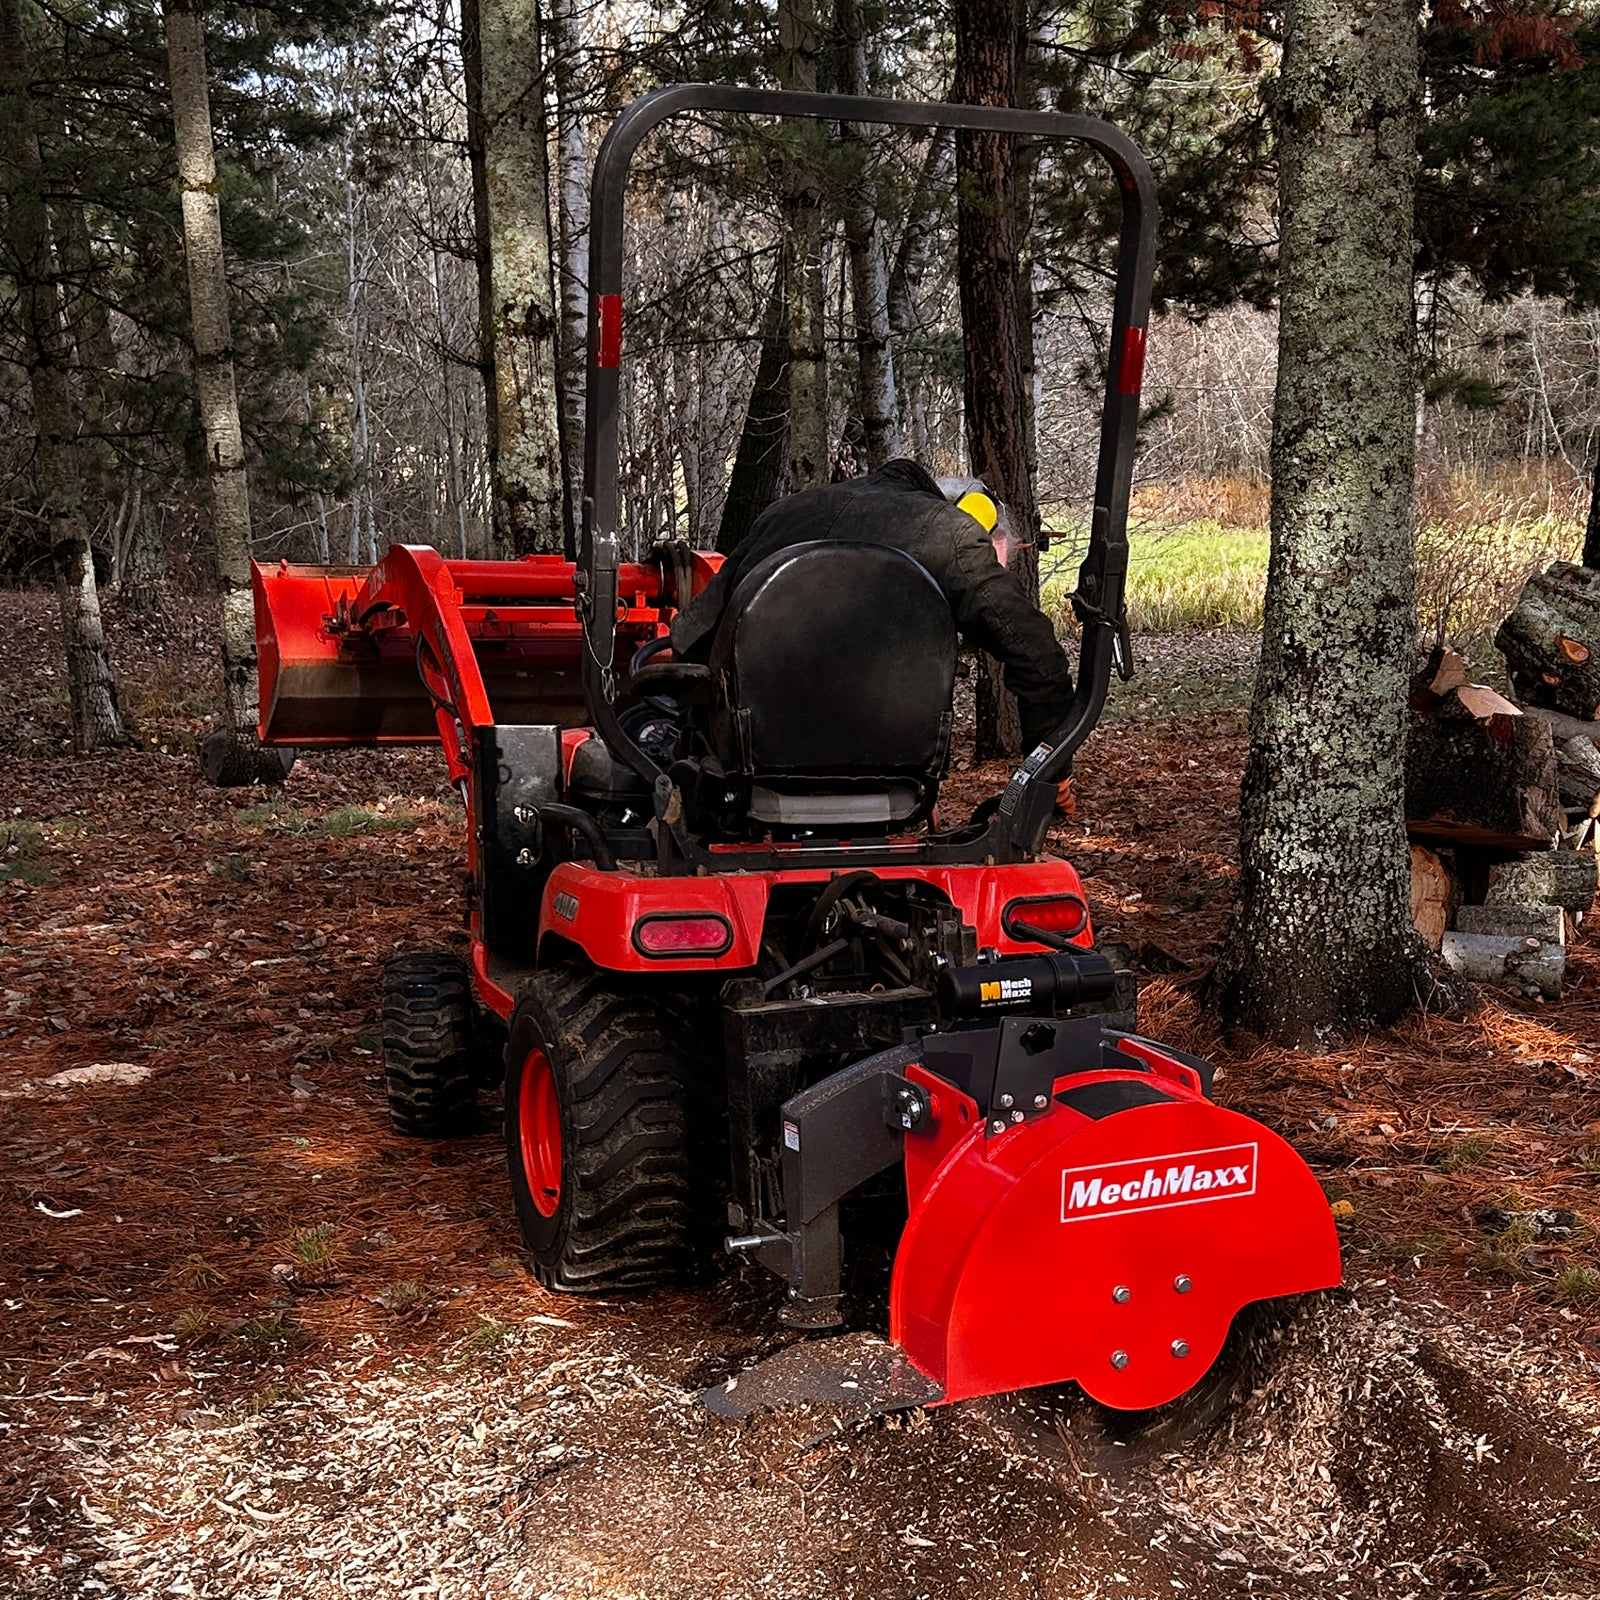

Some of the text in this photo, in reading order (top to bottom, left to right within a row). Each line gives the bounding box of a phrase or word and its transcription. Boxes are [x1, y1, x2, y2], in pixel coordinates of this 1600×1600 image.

[1001, 978, 1032, 989] Mech
[1002, 989, 1032, 999] Maxx
[1068, 1165, 1250, 1210] MechMaxx
